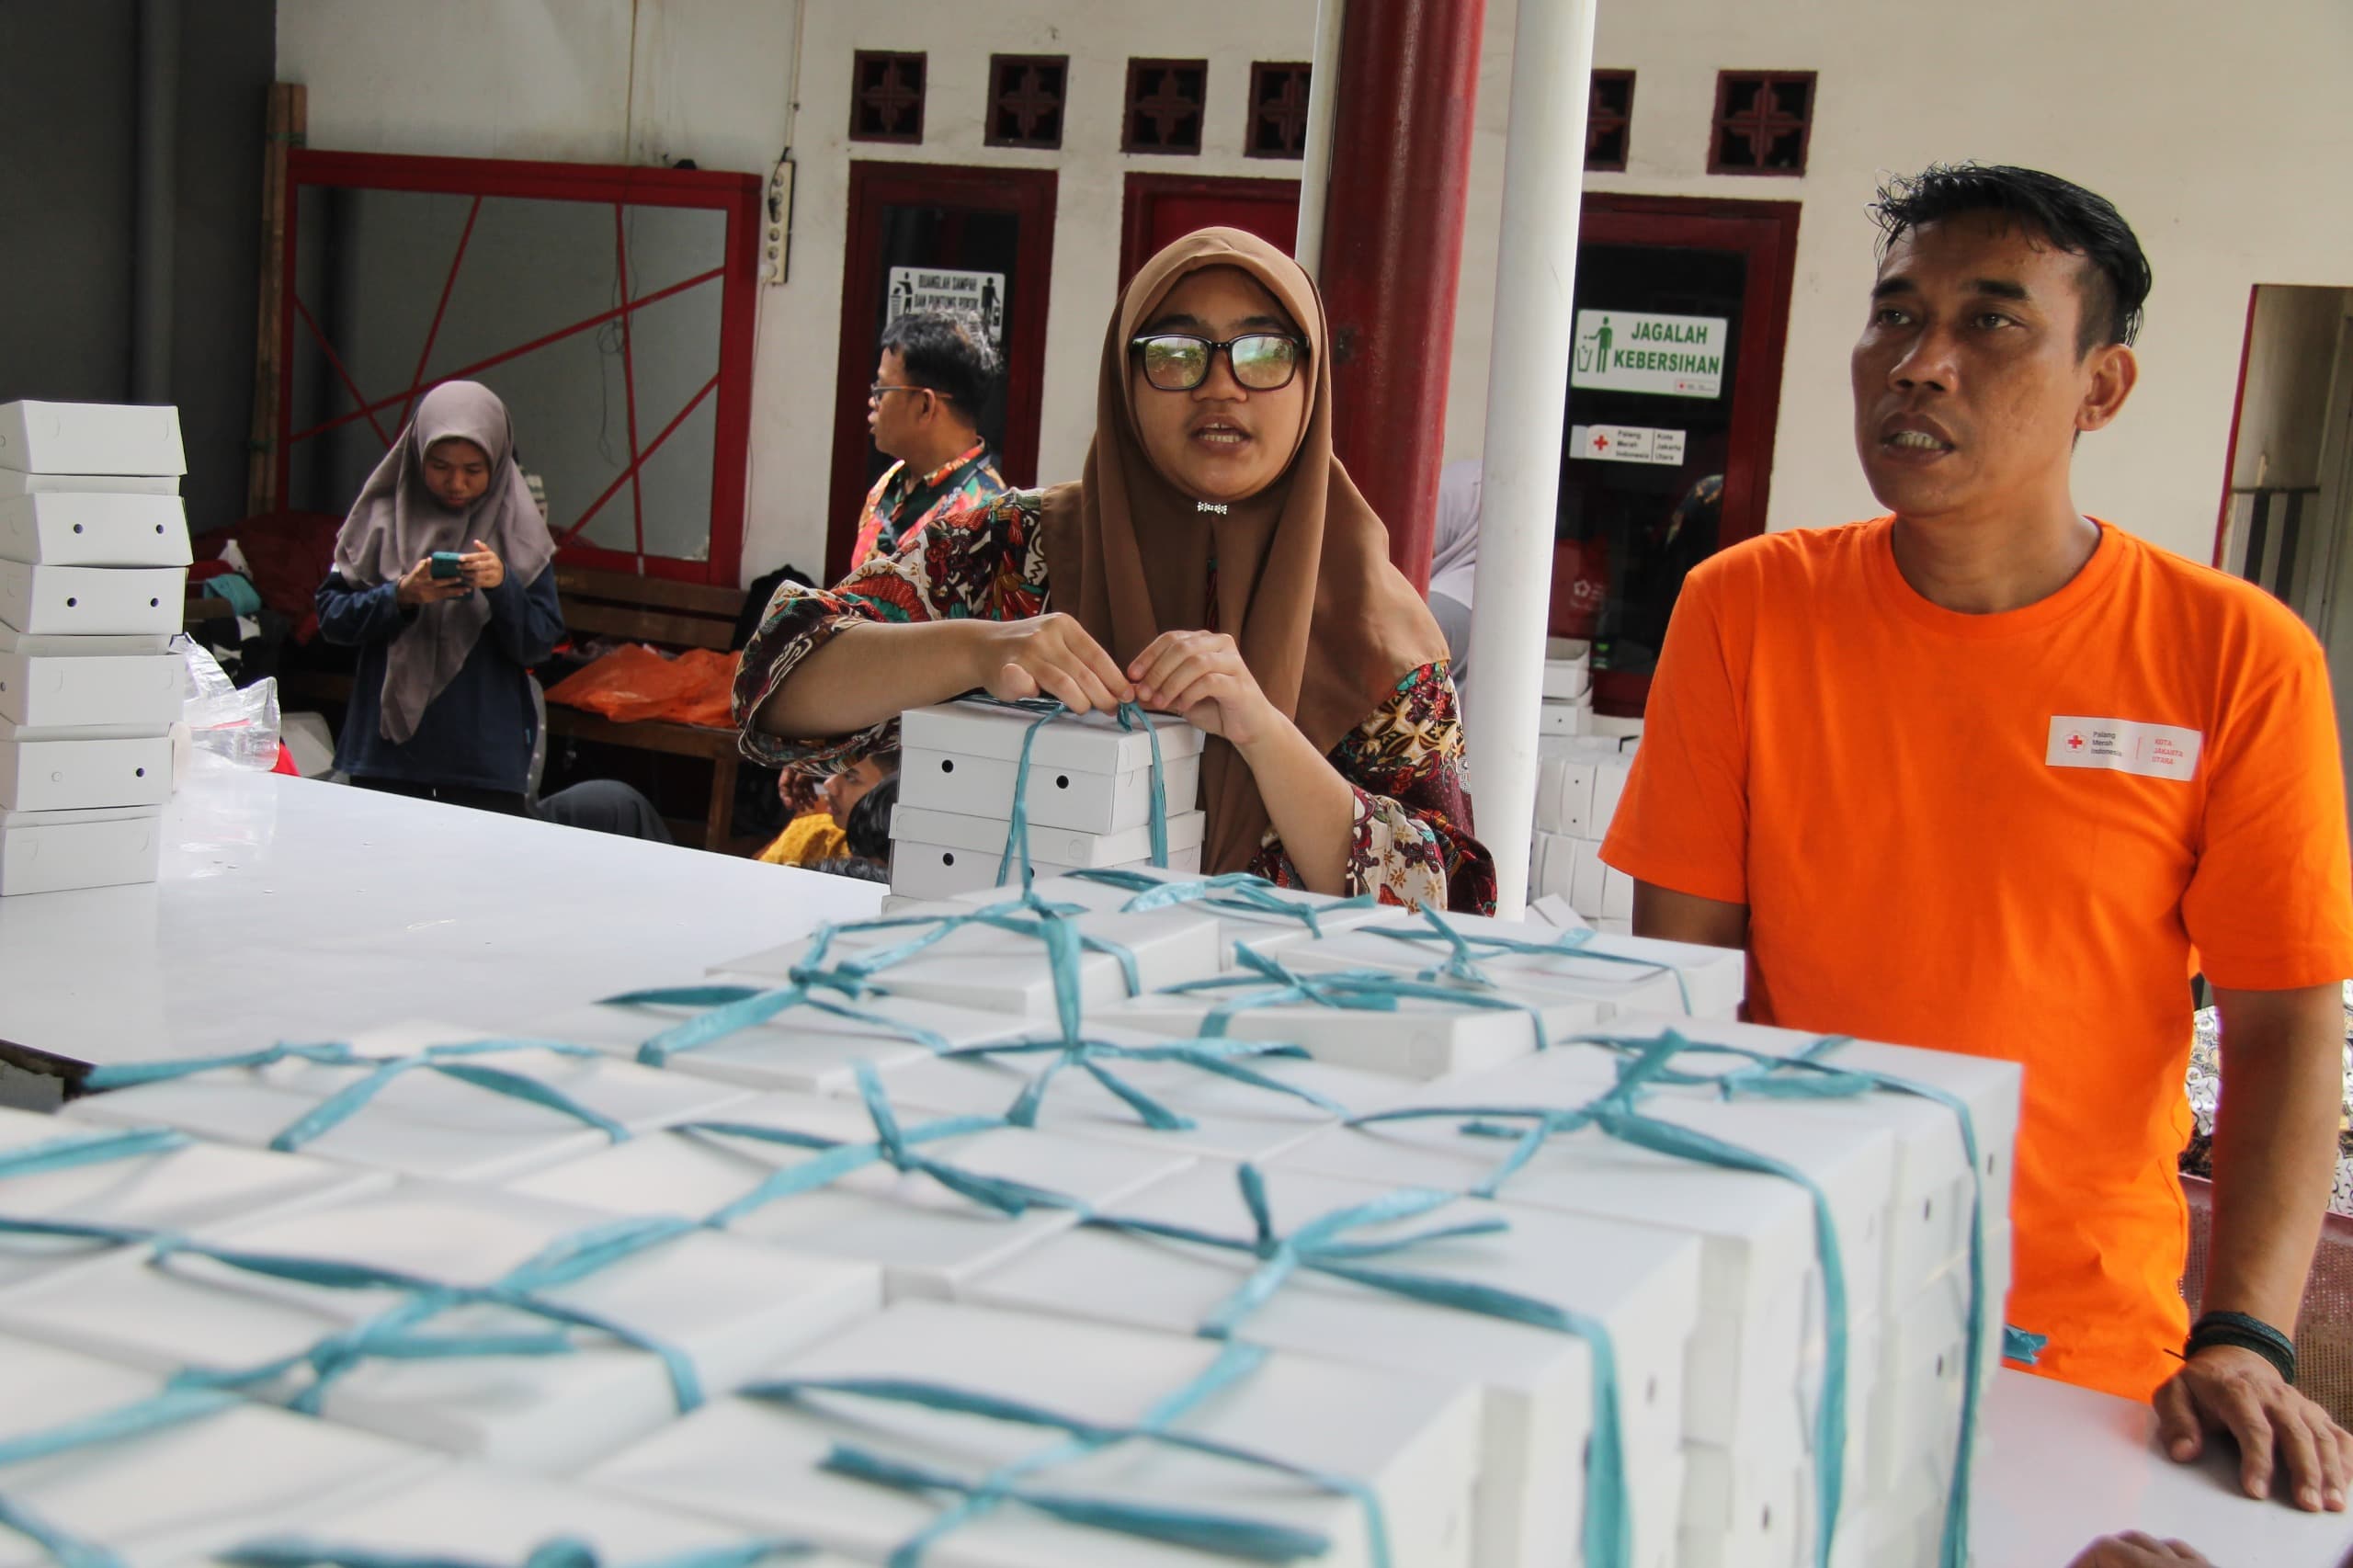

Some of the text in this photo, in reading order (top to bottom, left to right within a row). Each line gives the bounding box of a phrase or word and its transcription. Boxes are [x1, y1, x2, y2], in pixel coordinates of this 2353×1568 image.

[1631, 322, 1708, 345] JAGALAH
[1613, 349, 1720, 375] KEBERSIHAN
[1617, 429, 1642, 439] Palang
[1657, 433, 1673, 441] Kota
[1617, 439, 1638, 448] Merah
[1656, 443, 1682, 451] Jakarta
[1616, 450, 1650, 460] Indonesia
[1655, 453, 1675, 461] Utara
[2093, 731, 2116, 740] Palang
[2154, 738, 2173, 746] KOTA
[2091, 748, 2122, 757] Indonesia
[2154, 747, 2184, 757] JAKARTA
[2152, 756, 2175, 766] UTARA
